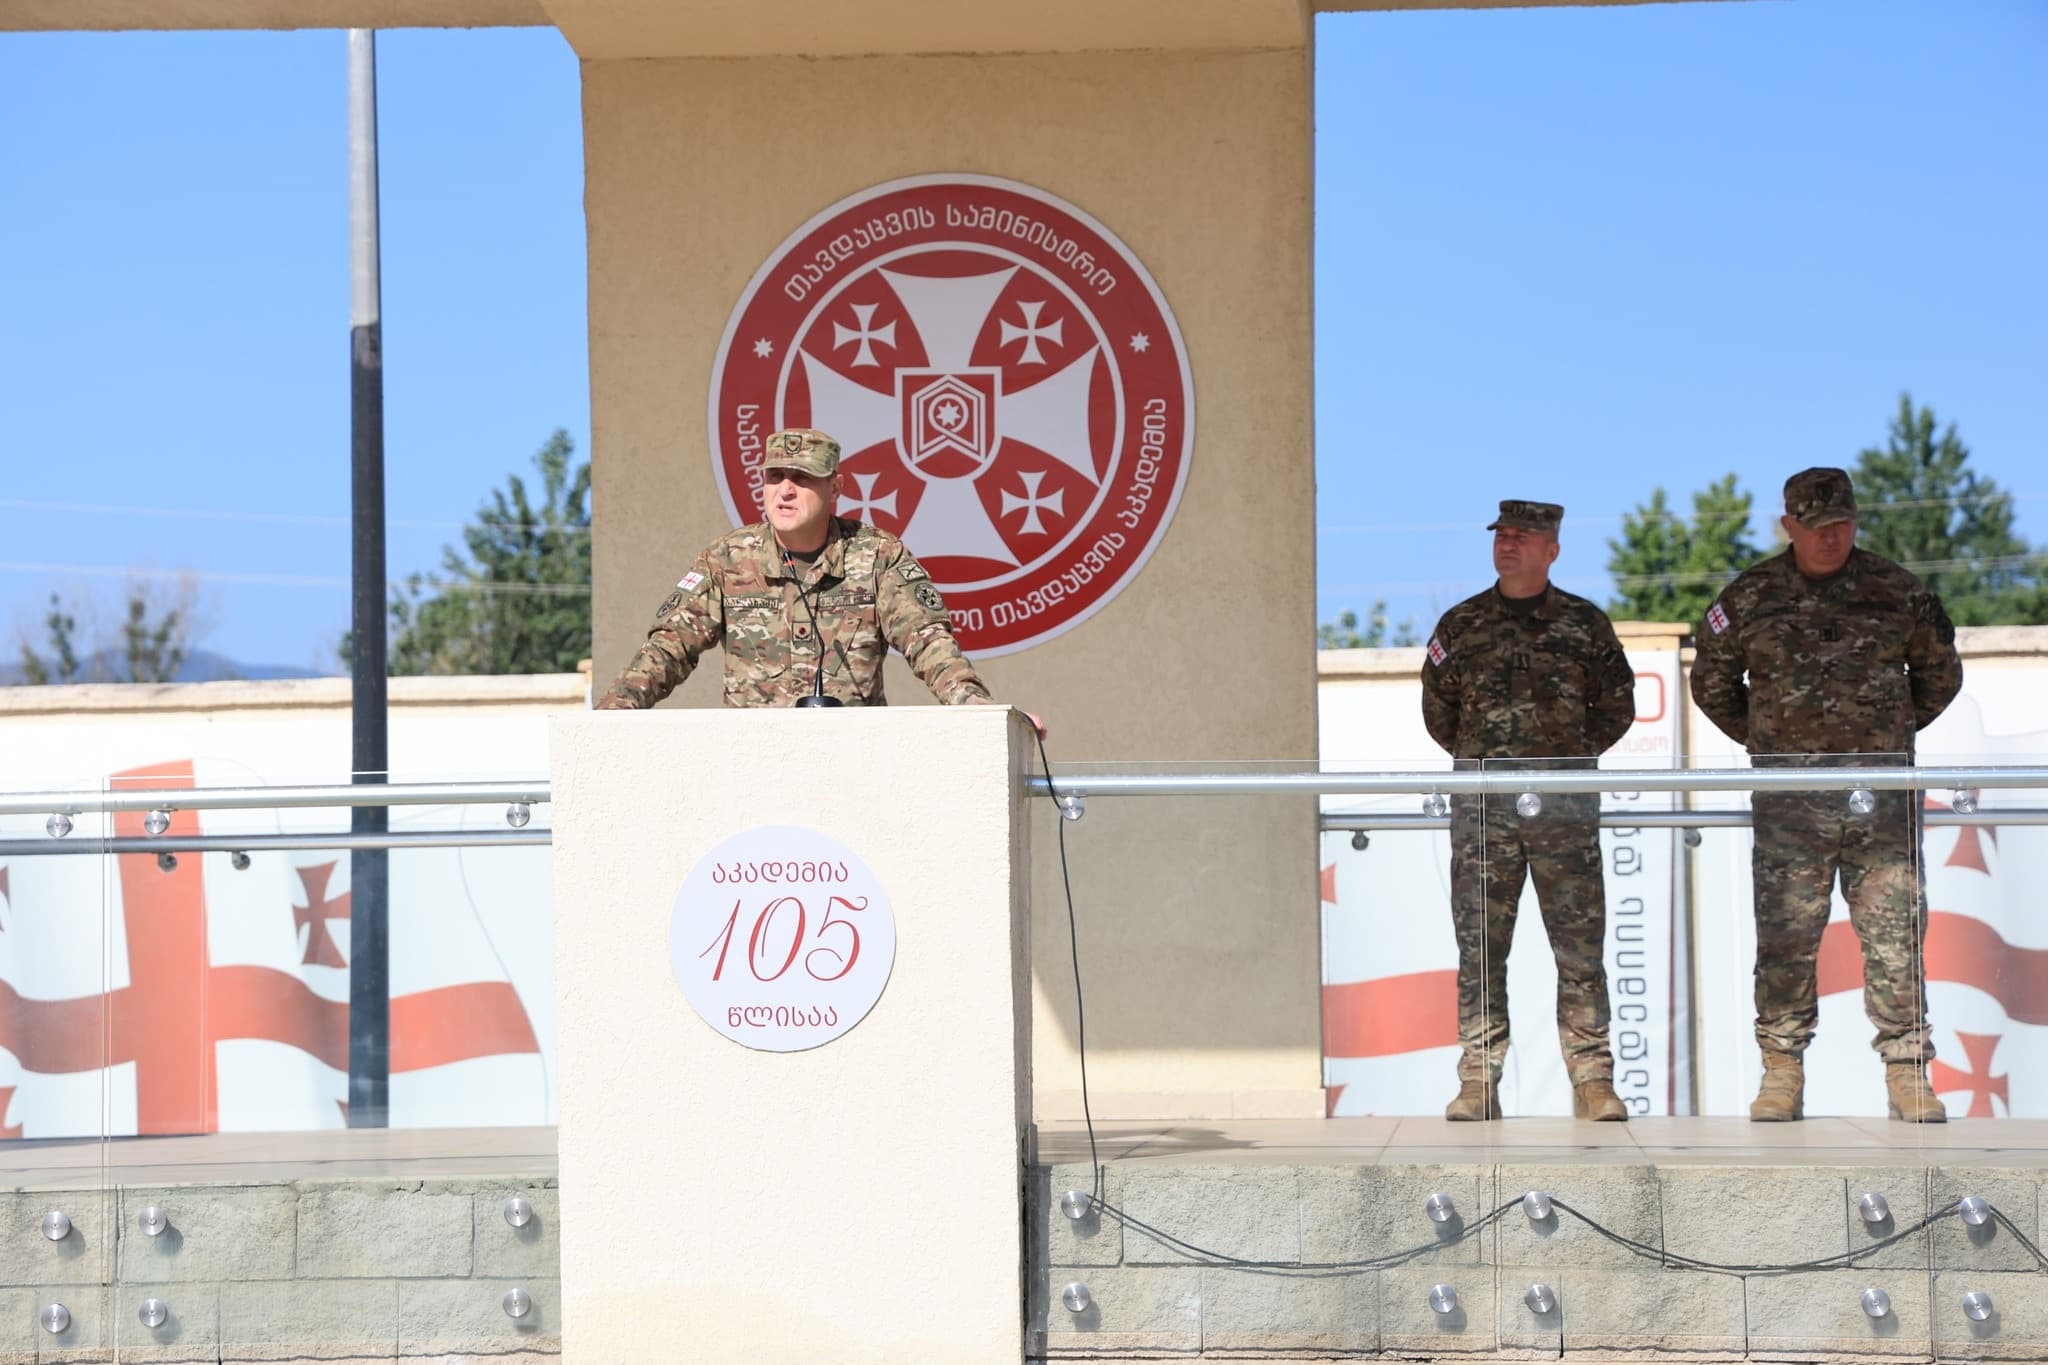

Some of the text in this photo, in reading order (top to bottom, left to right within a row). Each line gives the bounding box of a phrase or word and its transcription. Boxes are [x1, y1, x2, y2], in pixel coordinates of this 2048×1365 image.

[784, 203, 1117, 301] თავდაცვის სამინისტრო
[991, 398, 1166, 628] თავდაცვის აკადემია
[712, 861, 848, 884] აკადემია
[699, 896, 868, 982] 105
[727, 1005, 838, 1028] წლისაა
